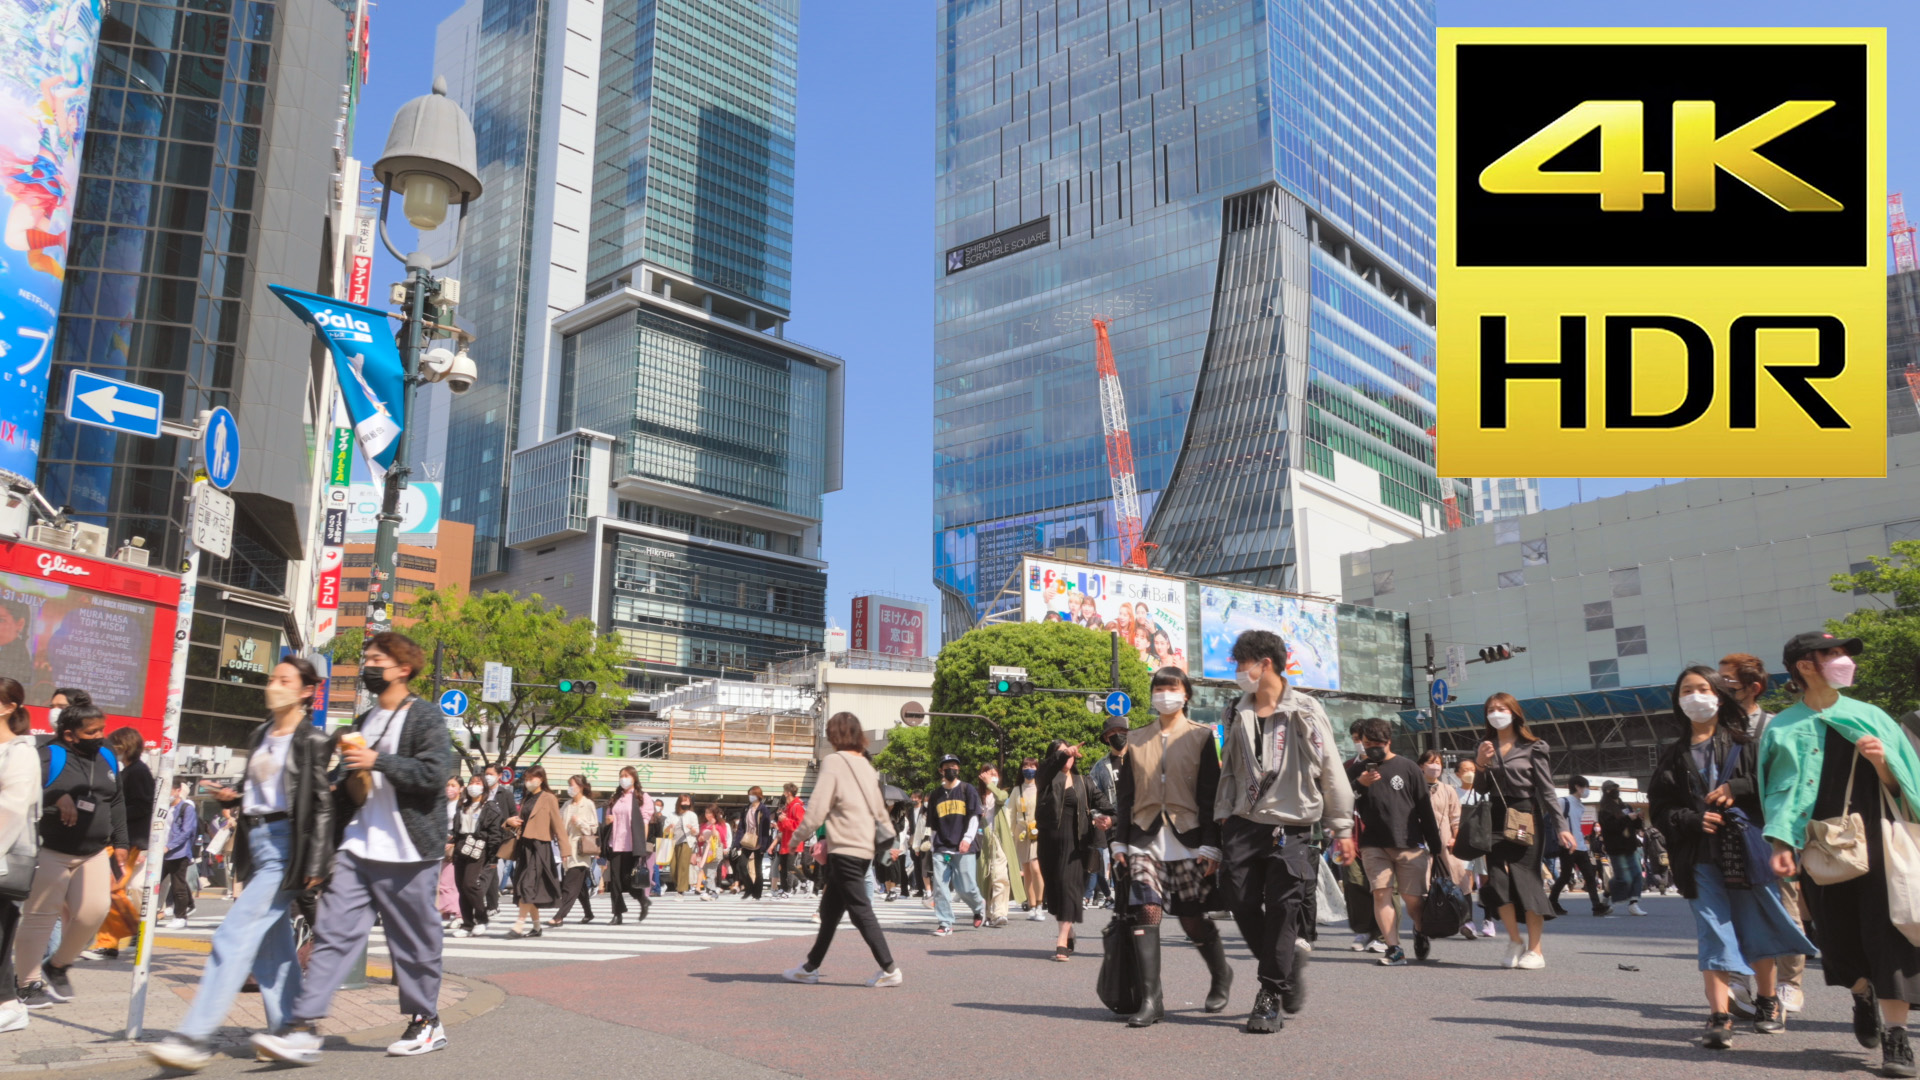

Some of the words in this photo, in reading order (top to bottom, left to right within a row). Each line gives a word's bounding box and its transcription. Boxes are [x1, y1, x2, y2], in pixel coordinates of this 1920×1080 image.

[965, 237, 1002, 256] SHIBUYA
[965, 243, 1010, 266] SCRAMBLE
[1011, 231, 1047, 250] SQUARE
[353, 267, 367, 304] アイフル
[335, 451, 346, 482] ALSA
[37, 553, 90, 576] Glico
[3, 589, 16, 601] 31
[17, 593, 47, 608] JULY
[322, 576, 336, 605] アコム
[1128, 583, 1181, 605] SoftBank
[79, 608, 104, 620] MURA
[105, 613, 128, 625] MASA
[81, 617, 98, 627] TOM
[100, 621, 125, 632] MISCH
[855, 600, 863, 650] ほけんの窓
[881, 609, 921, 628] ほけんの
[229, 659, 264, 673] COFFEE
[313, 680, 326, 711] MISE
[1277, 731, 1285, 750] FILA
[581, 761, 707, 784] 渋谷駅
